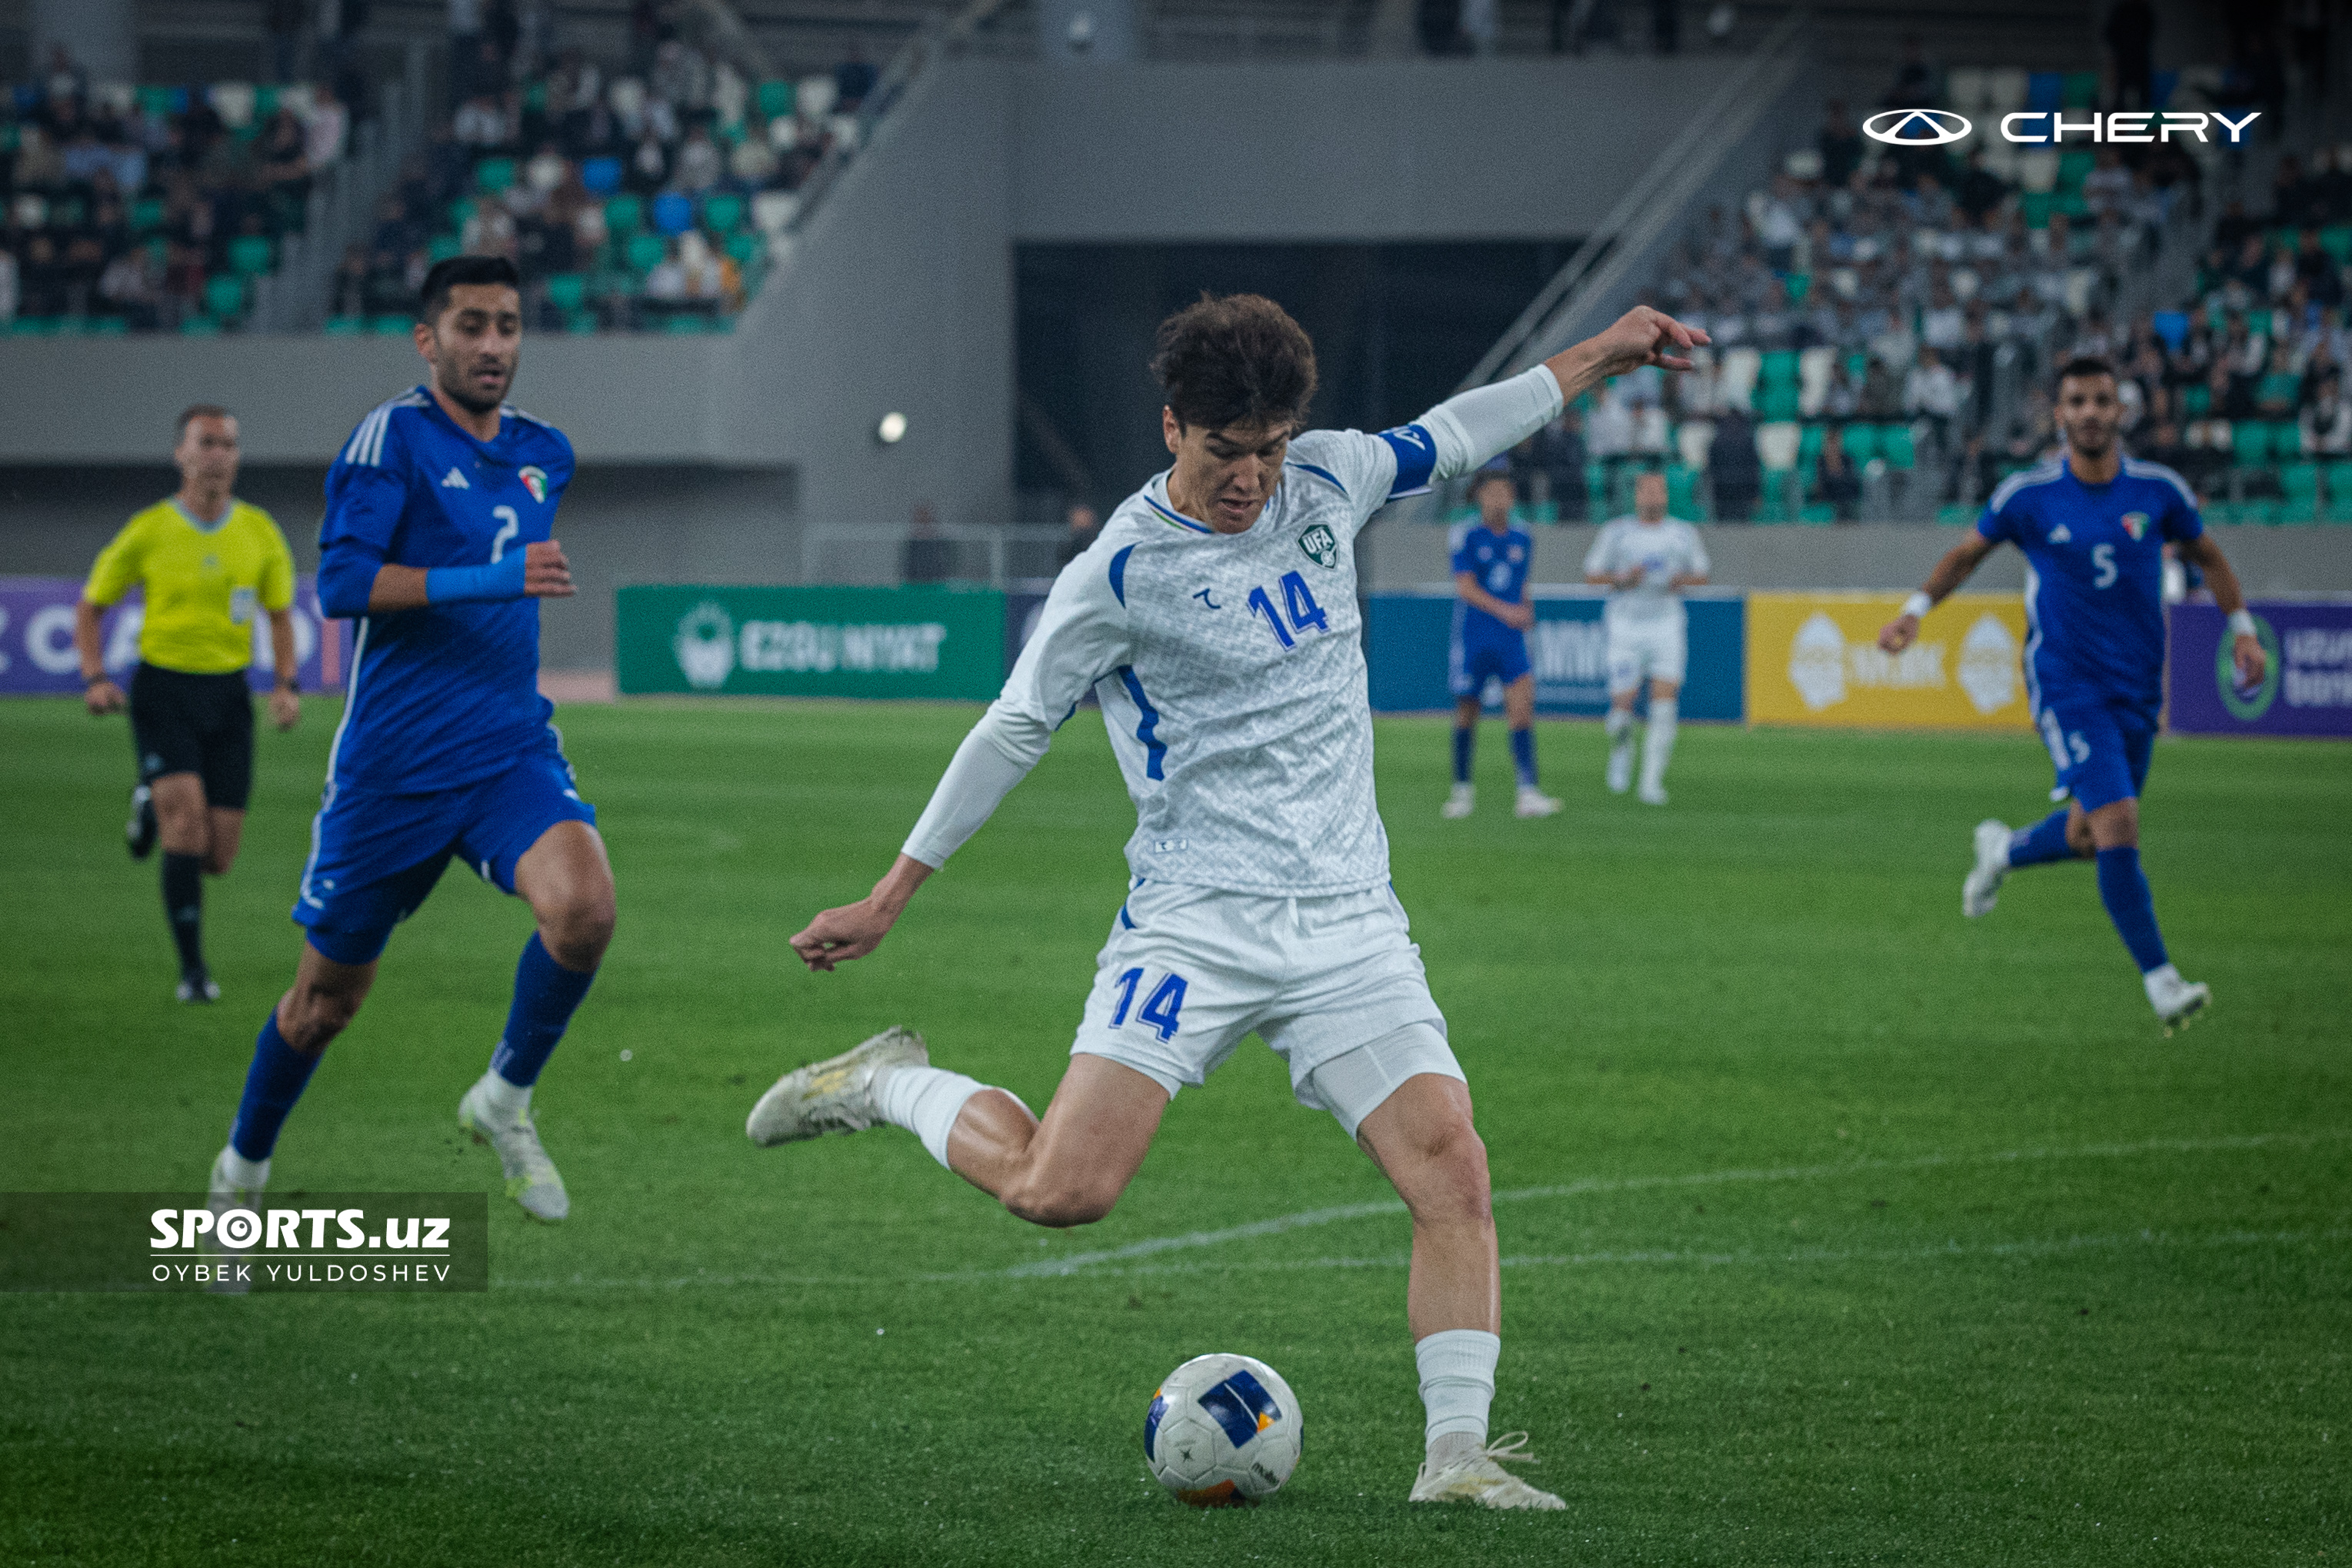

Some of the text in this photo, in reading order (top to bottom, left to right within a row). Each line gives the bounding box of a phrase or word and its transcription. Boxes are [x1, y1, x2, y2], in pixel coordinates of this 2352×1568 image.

[1302, 526, 1334, 554] UFA
[2091, 542, 2118, 590] 5
[1247, 569, 1331, 652] 14
[1108, 967, 1189, 1045] 14
